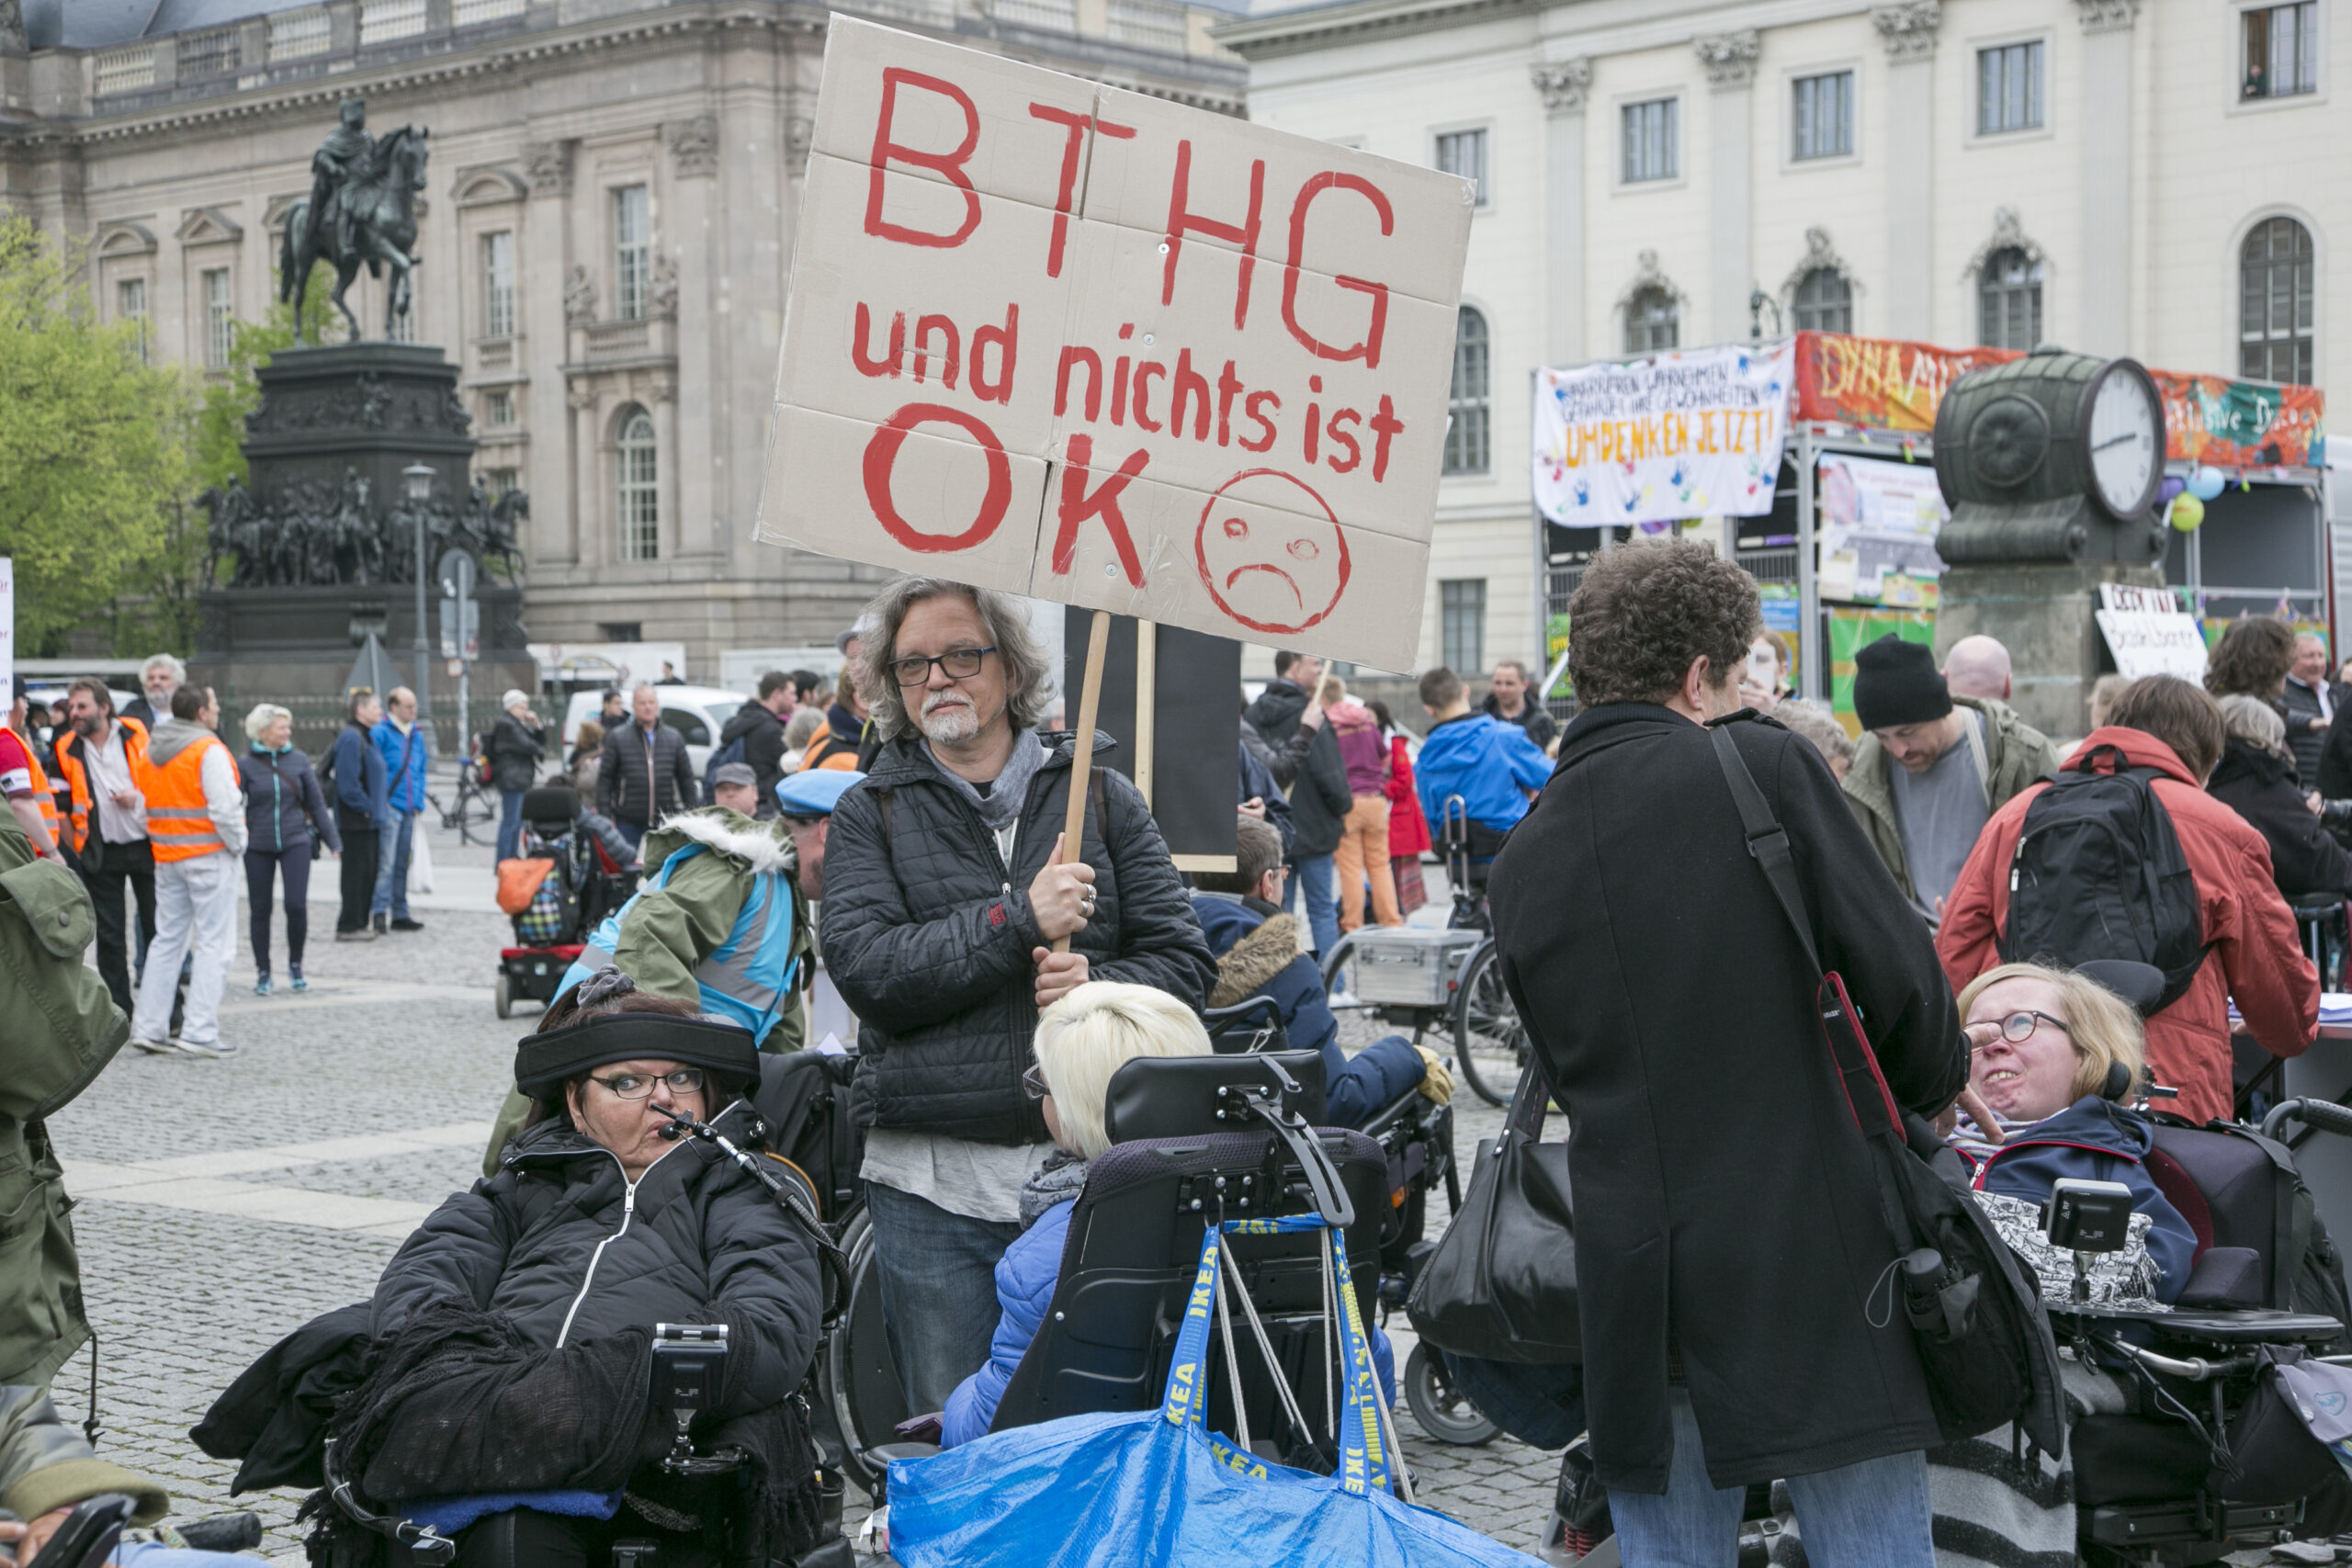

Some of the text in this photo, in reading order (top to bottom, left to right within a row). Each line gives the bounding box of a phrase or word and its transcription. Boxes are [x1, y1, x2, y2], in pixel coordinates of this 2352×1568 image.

[865, 67, 1393, 368] BTHG
[853, 301, 1405, 483] und nichts ist
[1566, 409, 1773, 468] UMDENKEN JETZT!
[863, 402, 1150, 589] OK
[1189, 1247, 1218, 1318] IKEA
[1166, 1362, 1196, 1426] KEA
[1206, 1438, 1267, 1480] KEA
[1345, 1448, 1365, 1495] IKE
